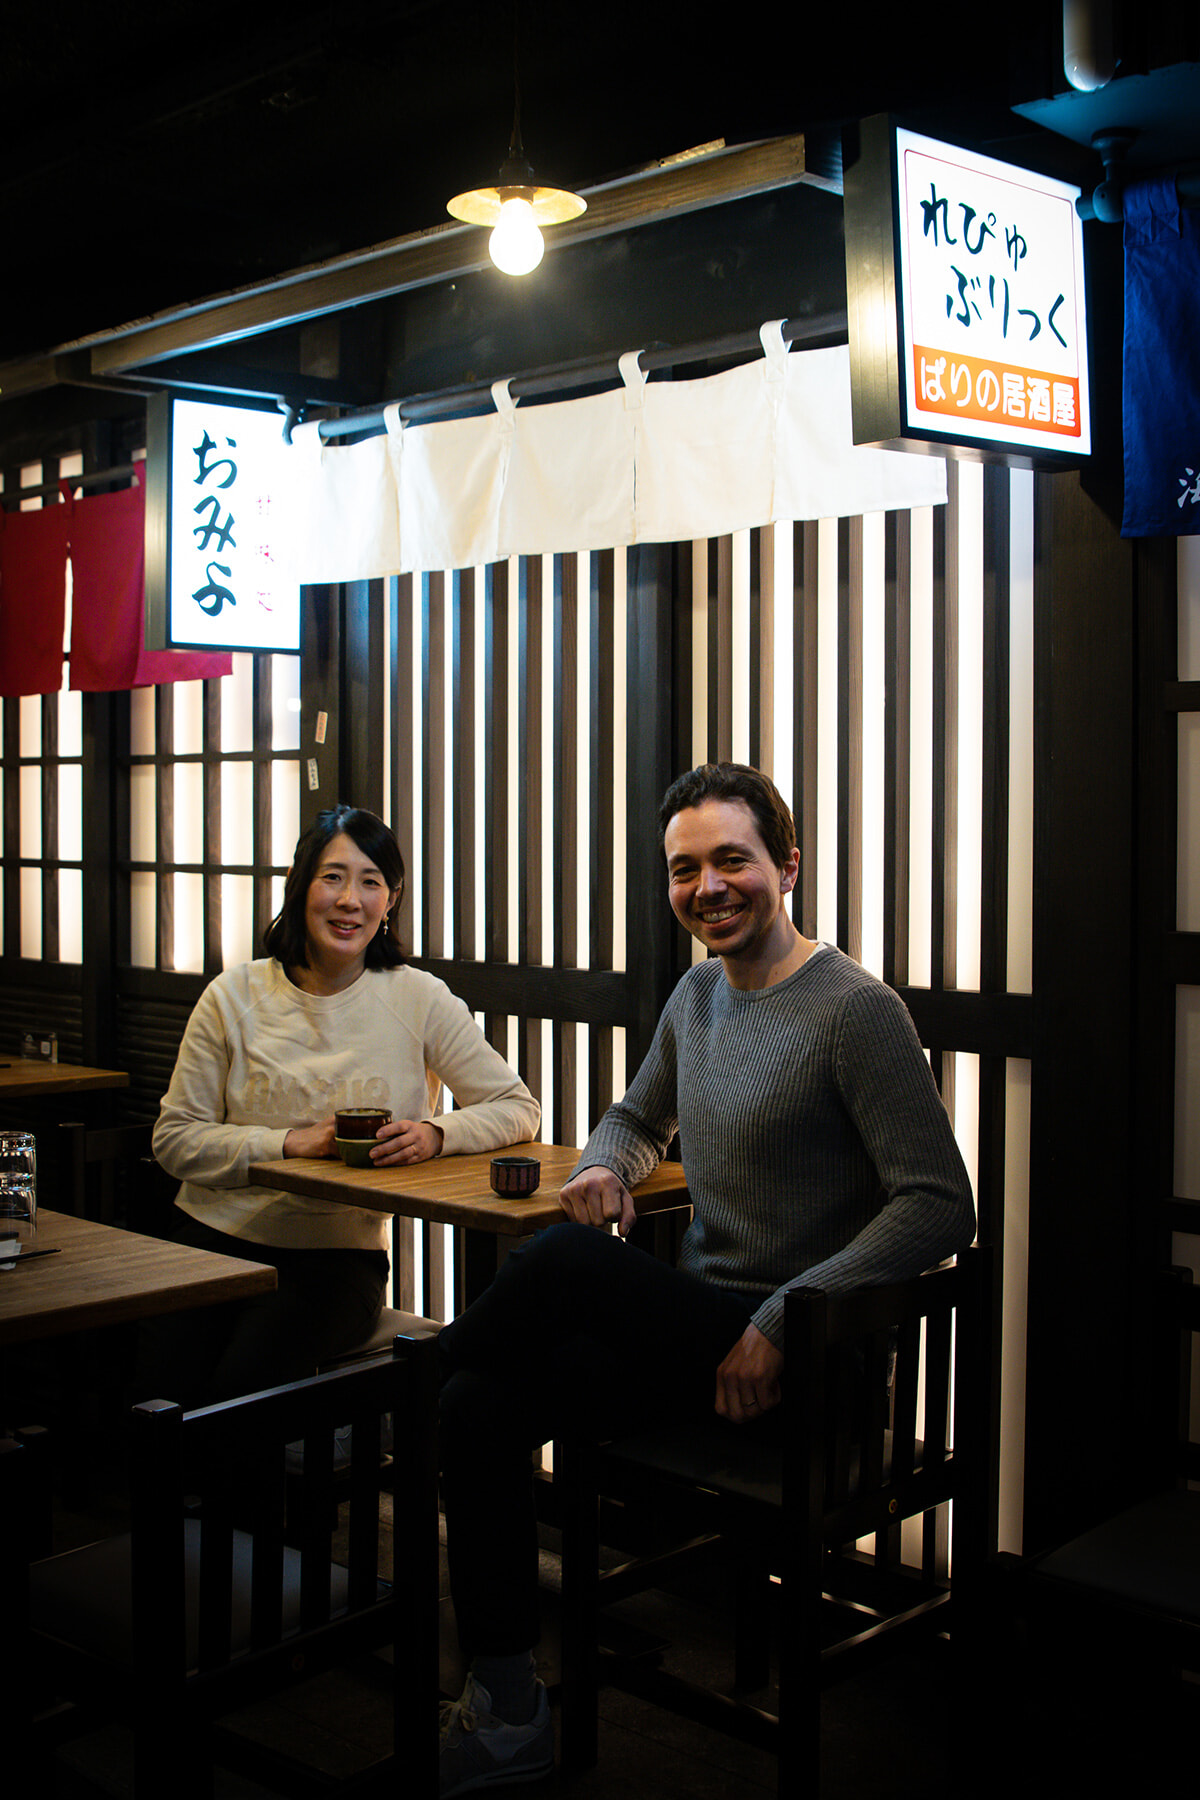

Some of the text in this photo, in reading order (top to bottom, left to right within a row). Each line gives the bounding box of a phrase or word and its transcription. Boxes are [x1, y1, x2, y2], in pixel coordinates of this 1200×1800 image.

[946, 265, 1068, 349] ぶりっく
[920, 356, 1077, 428] ぱりの居酒屋
